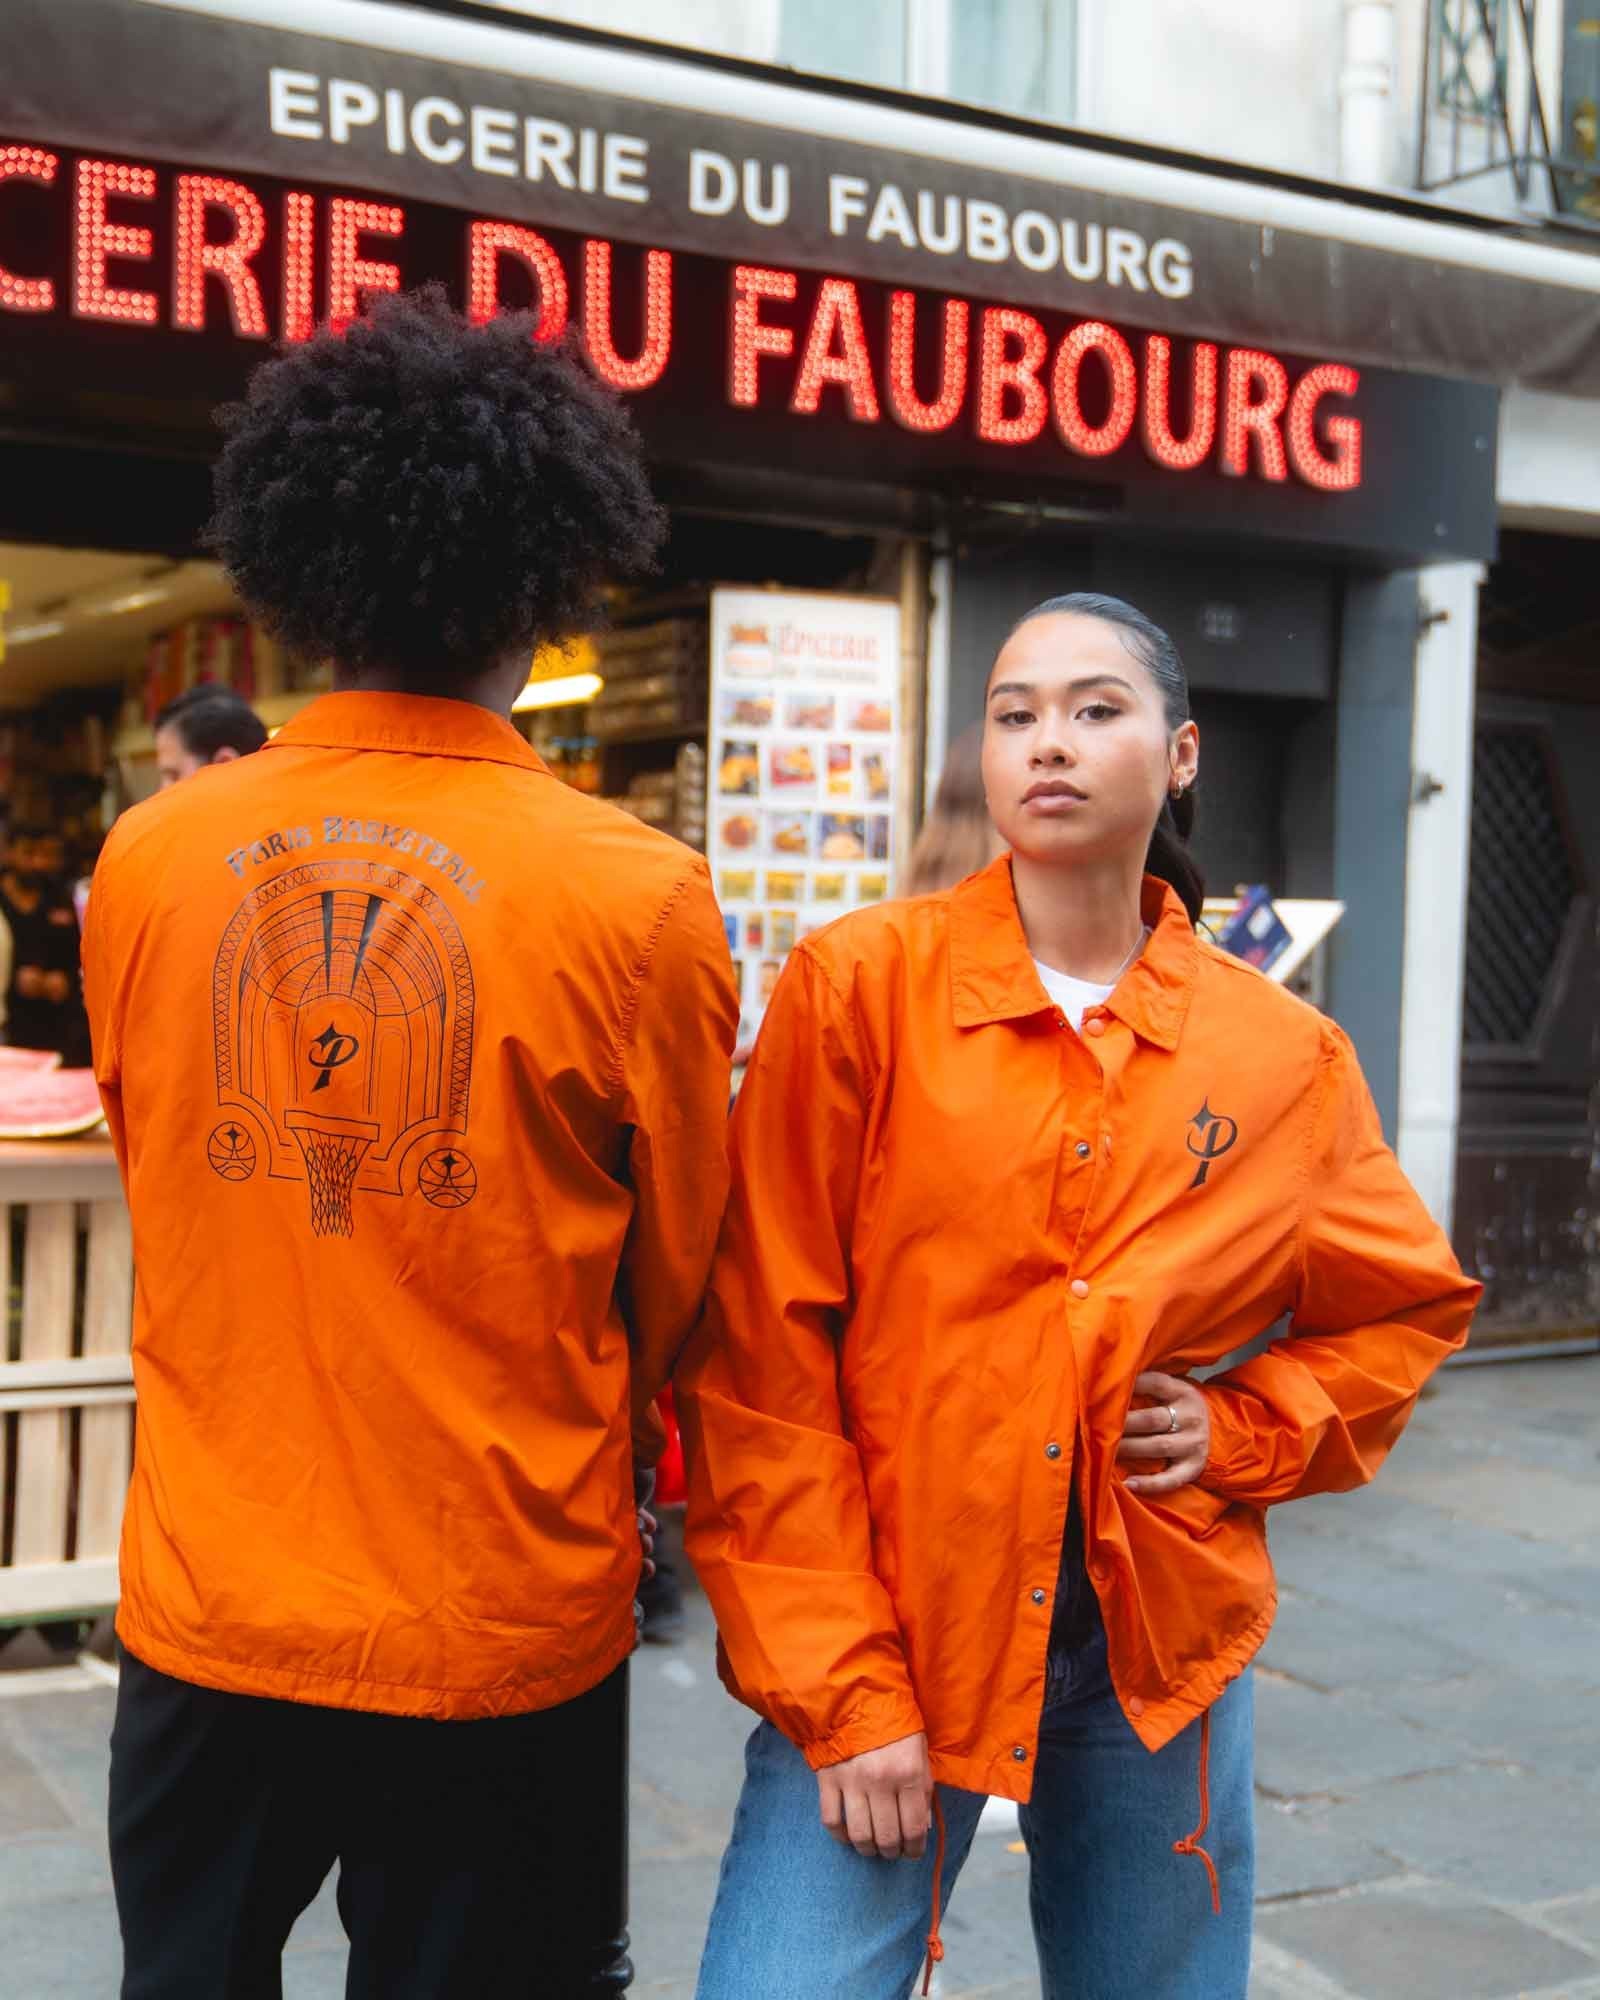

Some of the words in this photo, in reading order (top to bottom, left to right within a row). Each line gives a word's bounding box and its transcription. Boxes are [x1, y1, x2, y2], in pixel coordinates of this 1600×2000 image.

[268, 67, 650, 203] EPICERIE
[688, 150, 789, 226] DU
[830, 177, 1194, 299] FAUBOURG
[469, 222, 673, 388] DU
[731, 266, 1362, 490] FAUBOURG
